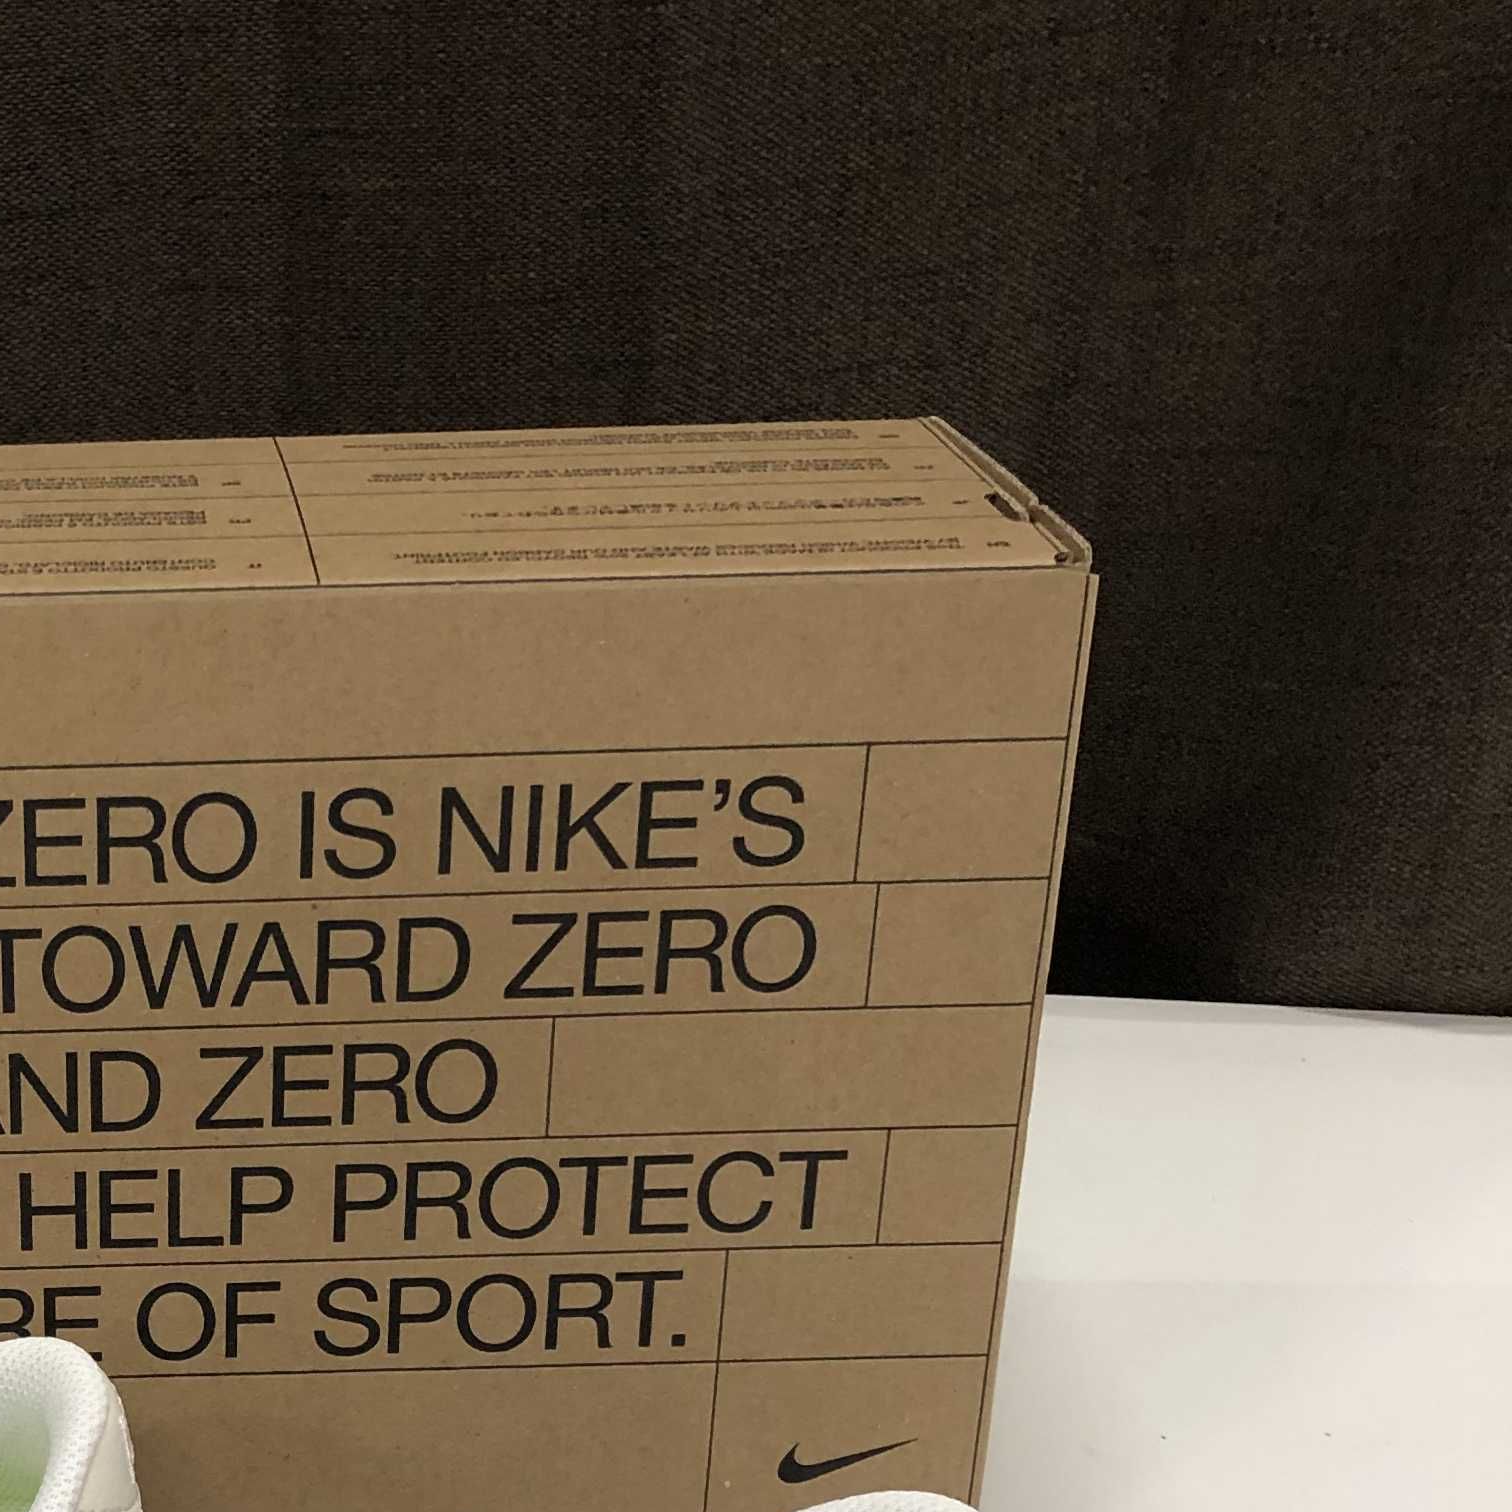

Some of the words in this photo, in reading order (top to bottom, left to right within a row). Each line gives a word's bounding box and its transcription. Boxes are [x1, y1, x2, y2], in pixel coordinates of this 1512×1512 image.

[299, 787, 396, 880] IS
[437, 775, 805, 875] NIKE’S
[503, 905, 817, 999] ZERO
[195, 1038, 498, 1130] ZERO
[18, 1166, 294, 1252] HELP
[332, 1150, 848, 1243] PROTECT
[136, 1281, 281, 1360] OF
[313, 1270, 686, 1356] SPORT.
